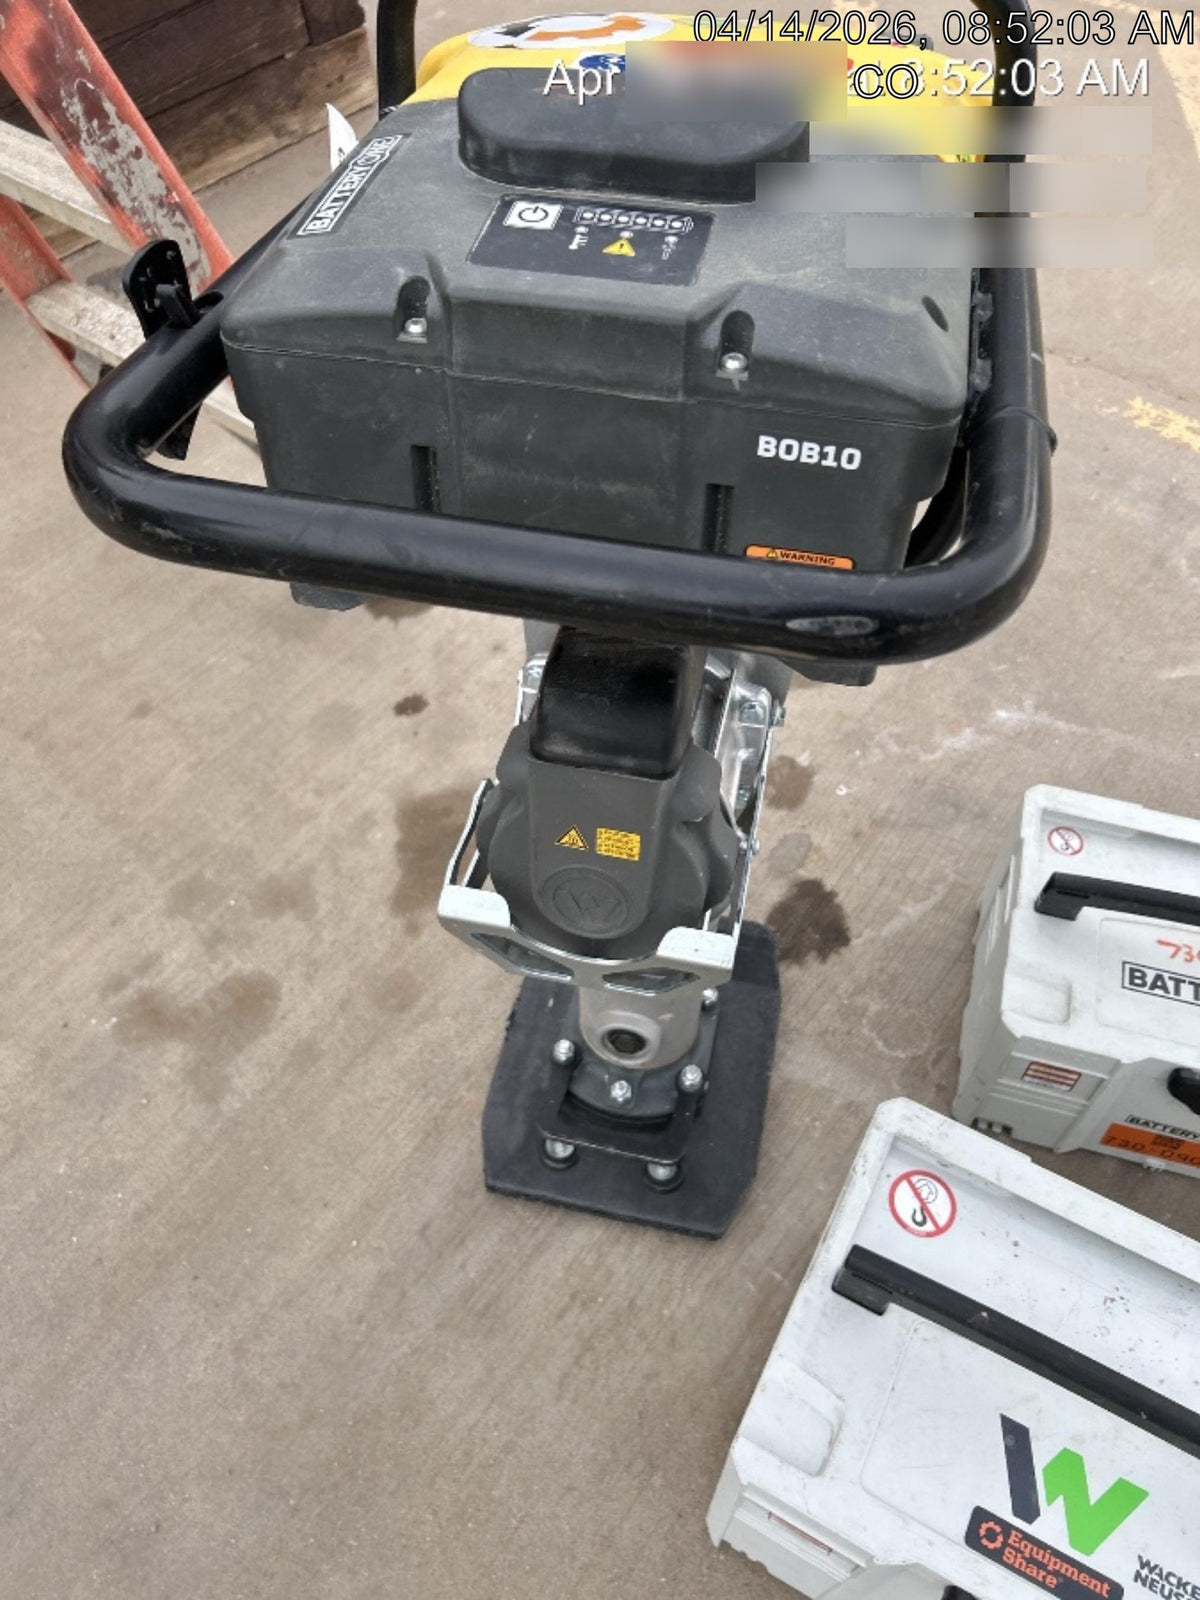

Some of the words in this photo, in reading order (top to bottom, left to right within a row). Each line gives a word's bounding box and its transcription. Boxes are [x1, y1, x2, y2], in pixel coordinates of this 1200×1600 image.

[305, 165, 372, 230] BATTERY
[757, 434, 862, 470] BOB10
[779, 550, 836, 566] WARNING
[1156, 938, 1200, 963] 73
[1128, 1116, 1200, 1140] BATTERY
[1002, 1546, 1058, 1588] Share
[1007, 1530, 1111, 1599] Equipment
